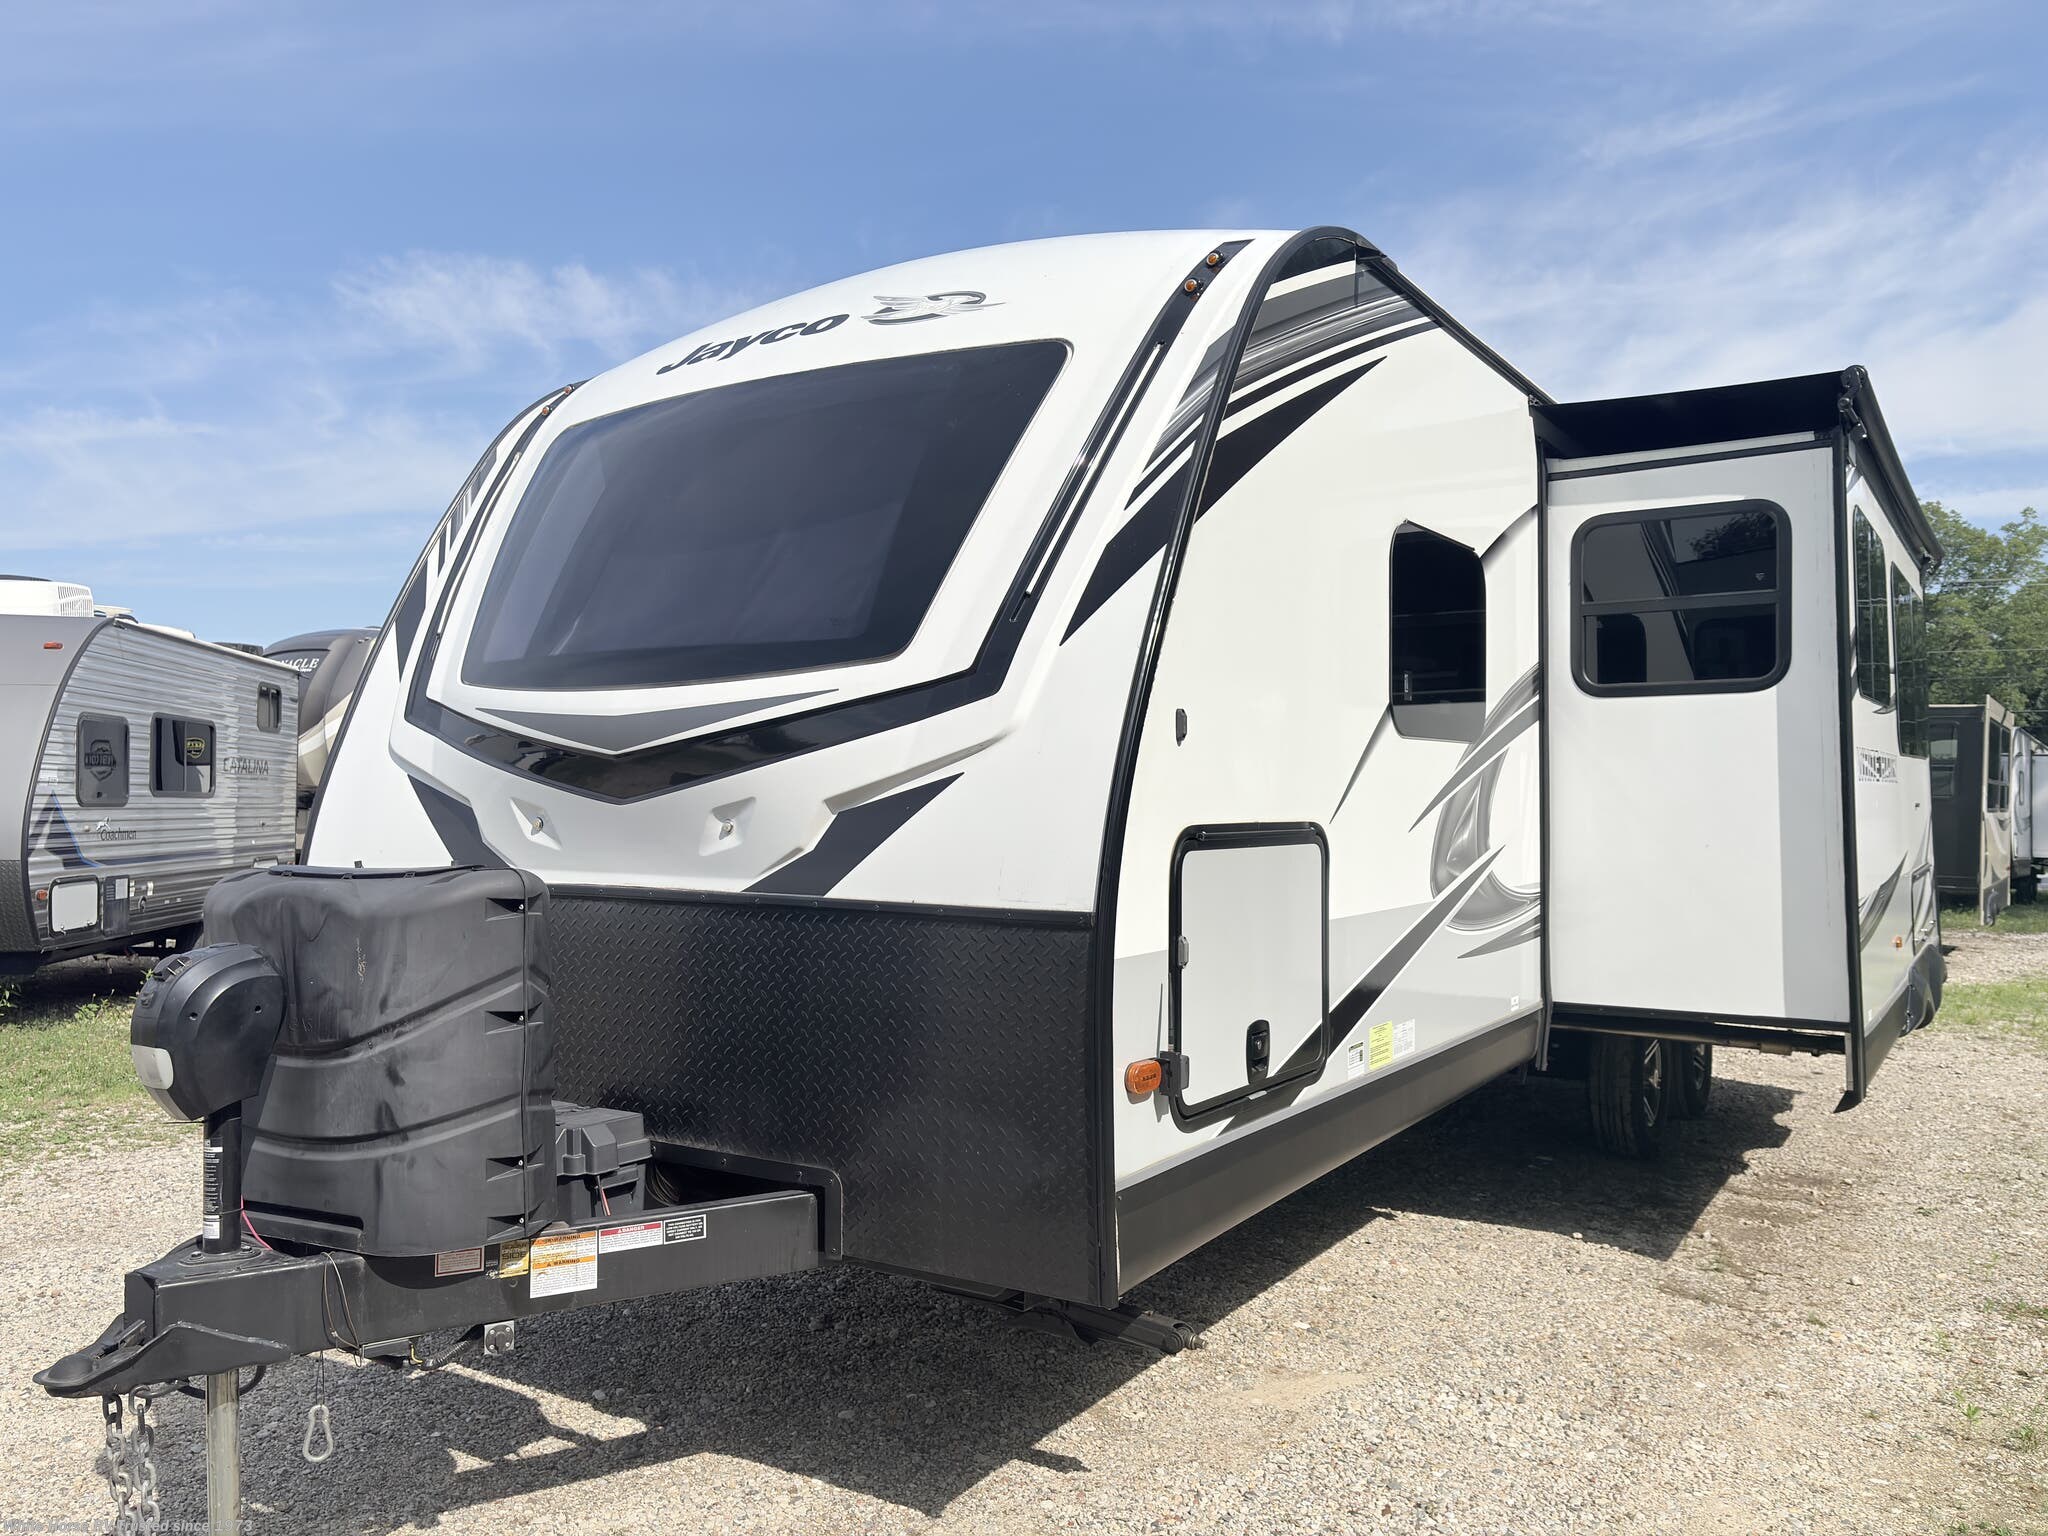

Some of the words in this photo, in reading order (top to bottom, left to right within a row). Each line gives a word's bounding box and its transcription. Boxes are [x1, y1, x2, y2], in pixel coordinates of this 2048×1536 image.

[656, 313, 850, 375] Jayco
[223, 757, 269, 775] CATALINA
[622, 1225, 645, 1233] DANGER
